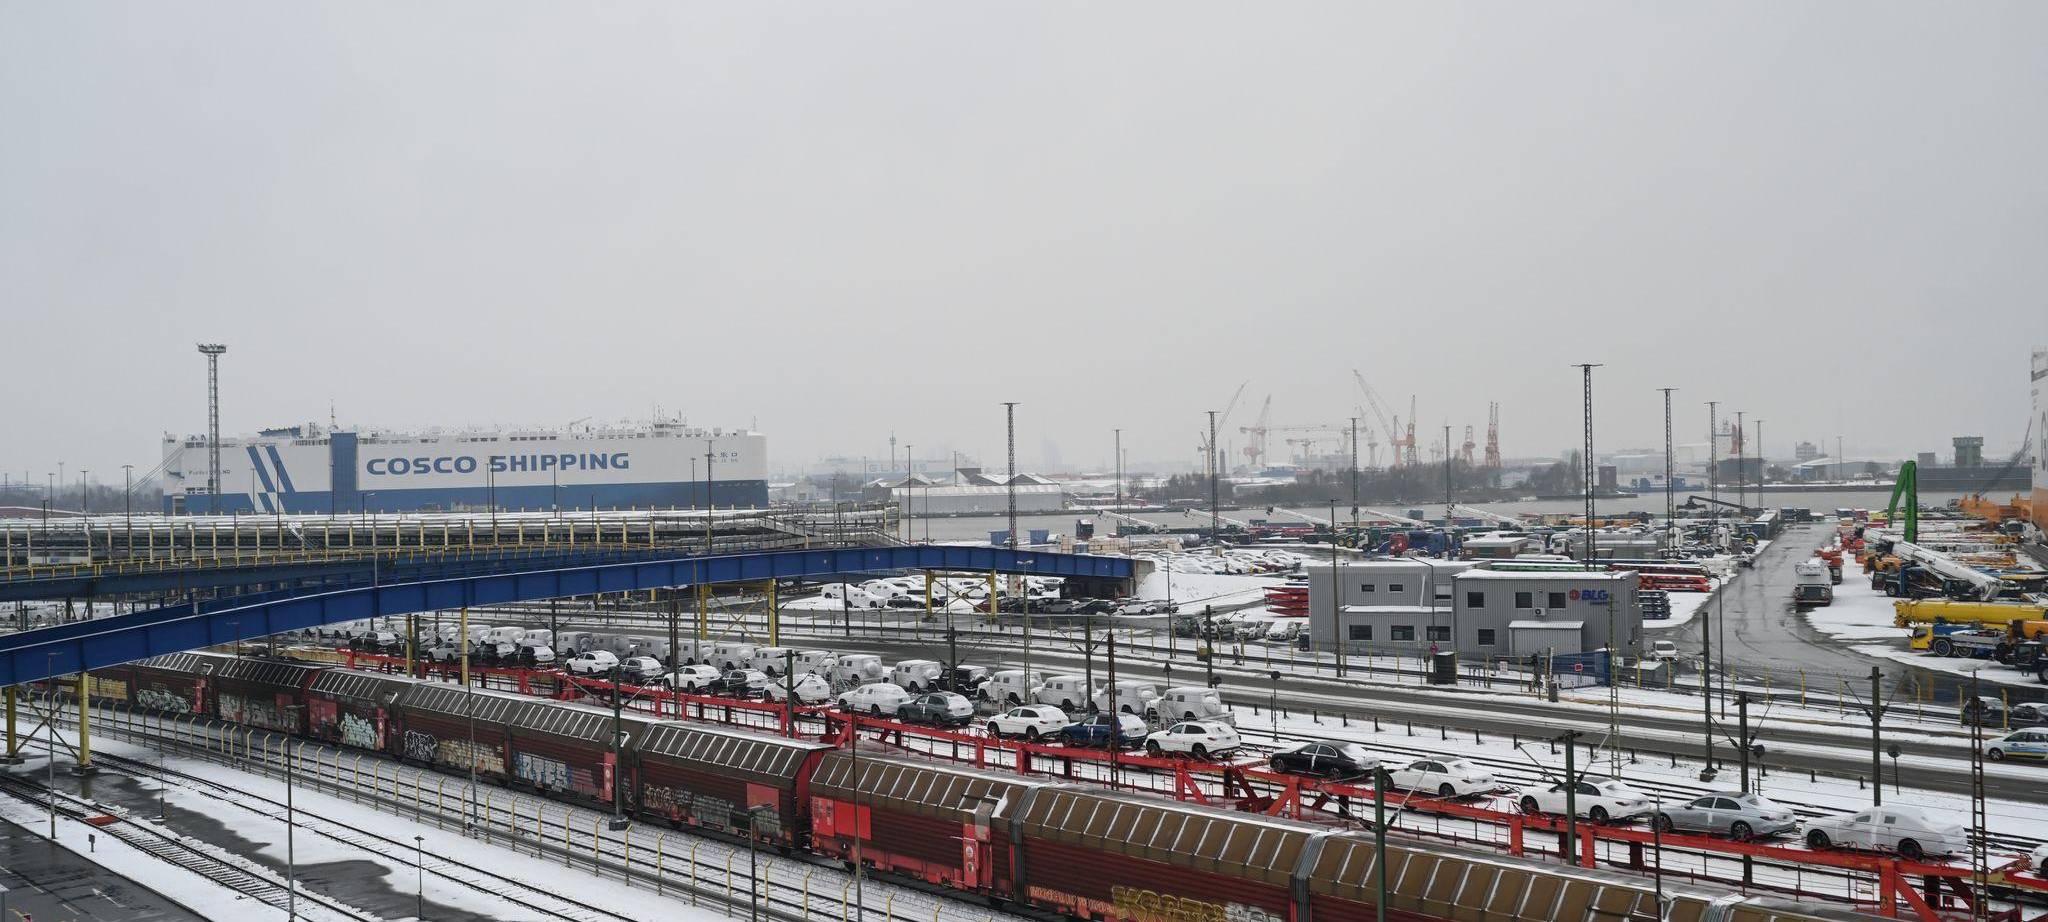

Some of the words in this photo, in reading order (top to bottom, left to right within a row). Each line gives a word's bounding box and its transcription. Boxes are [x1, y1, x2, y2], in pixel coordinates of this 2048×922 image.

[366, 456, 477, 476] COSCO
[489, 452, 629, 473] SHIPPING
[868, 463, 928, 473] GLOVIS
[1581, 589, 1608, 600] BLG
